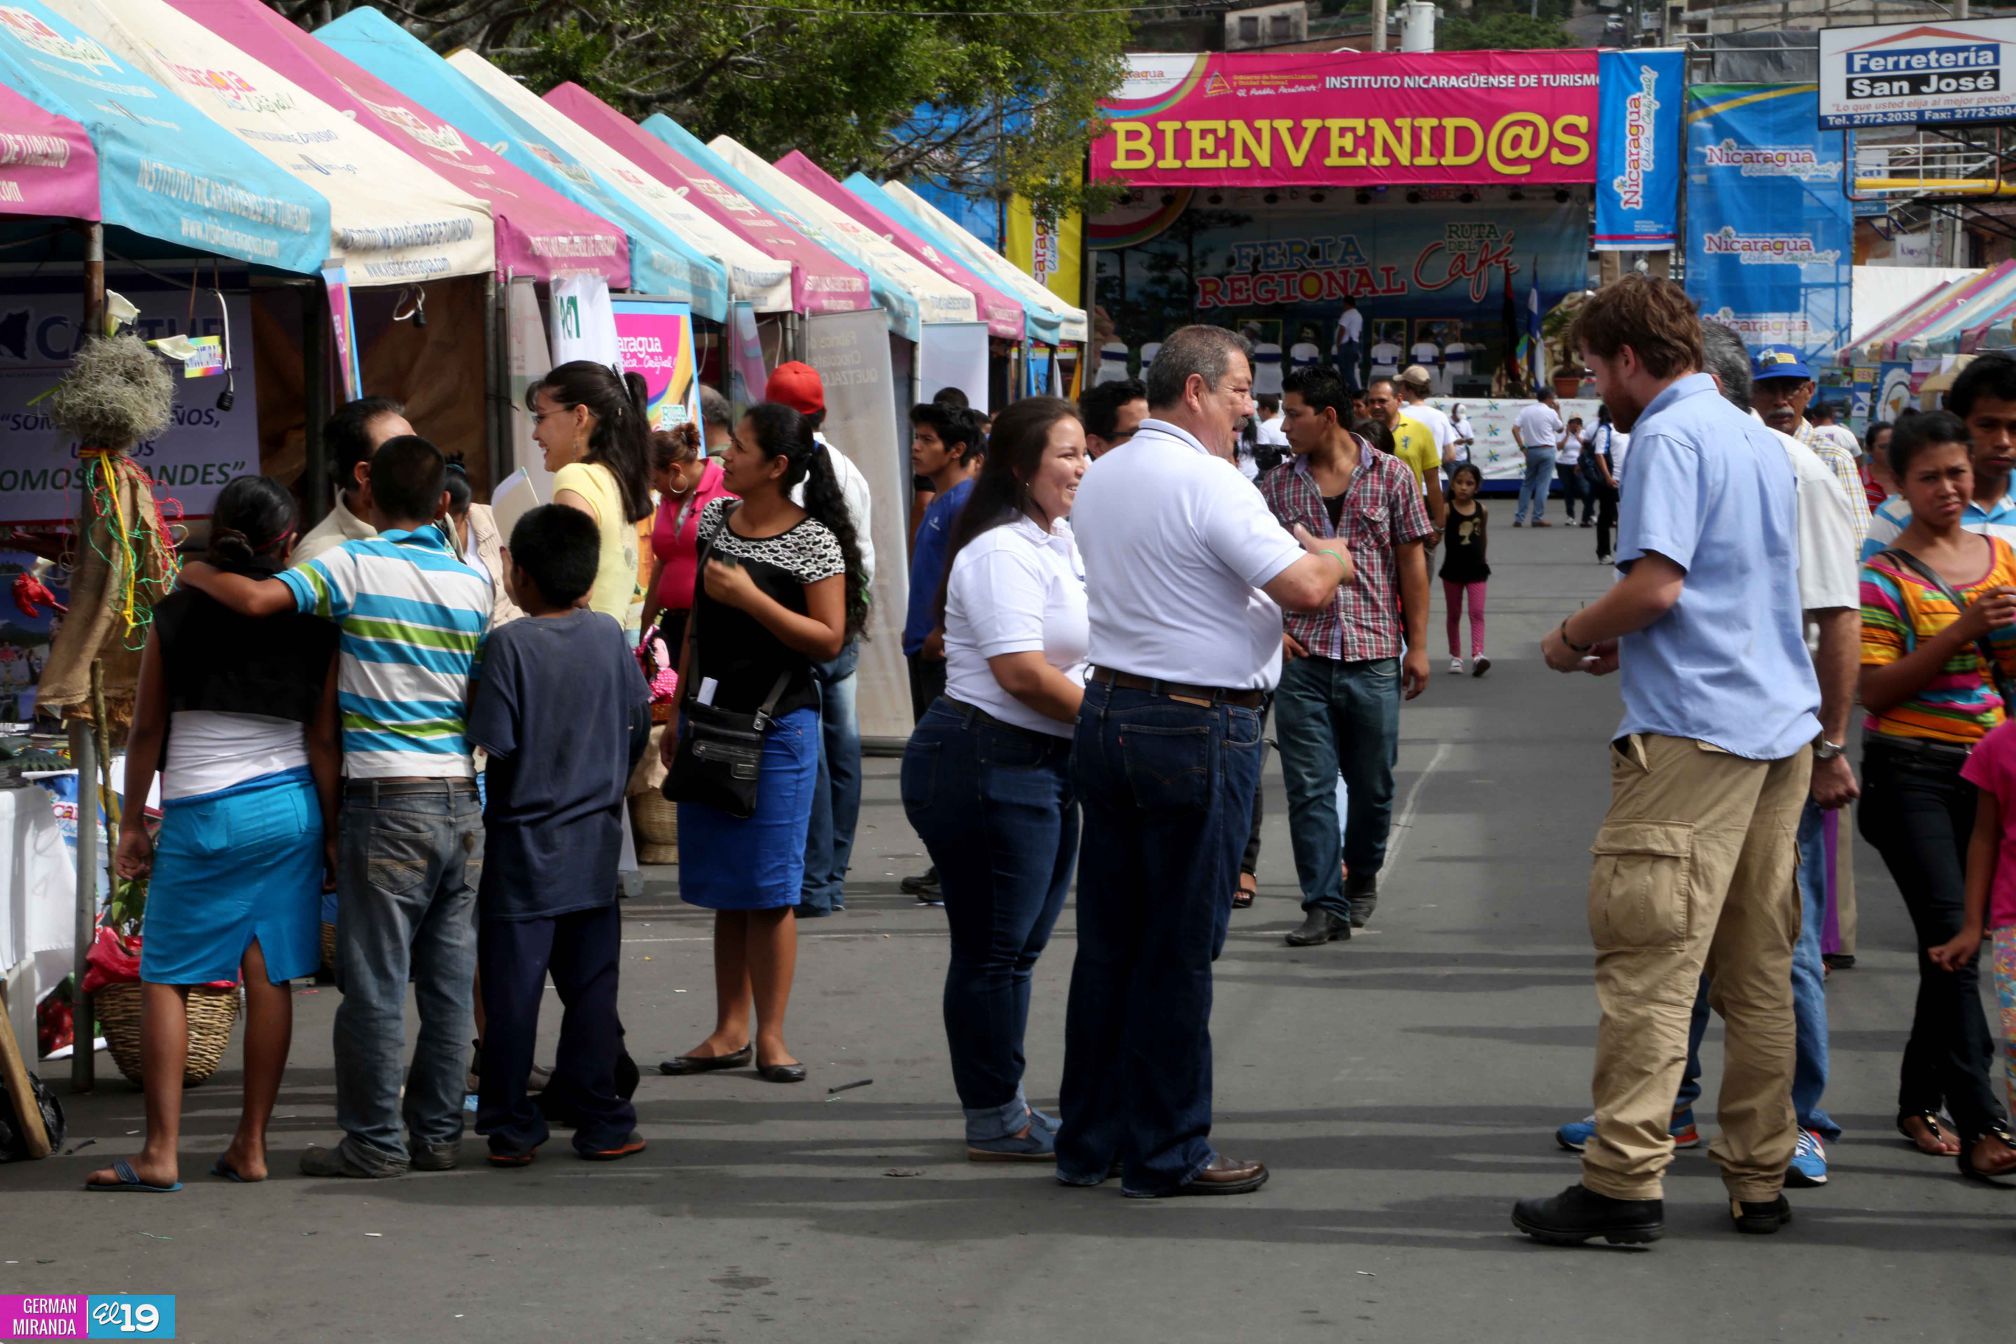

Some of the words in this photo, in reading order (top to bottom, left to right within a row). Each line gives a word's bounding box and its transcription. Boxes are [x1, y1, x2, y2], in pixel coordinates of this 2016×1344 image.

[1852, 47, 1994, 72] Ferretería
[1325, 75, 1400, 89] INSTITUTO
[1404, 73, 1516, 88] NICARAGÜENSE
[1519, 74, 1539, 87] DE
[1851, 78, 1910, 97] San
[1920, 71, 1995, 94] José
[1852, 104, 1872, 114] que
[1875, 99, 1904, 110] usted
[1907, 98, 1929, 111] elija
[1931, 97, 1945, 107] al
[1948, 96, 1974, 109] mejor
[1827, 114, 1849, 125] Tel.
[1853, 111, 1917, 124] 2772-2035
[1924, 109, 1951, 120] Fax:
[1110, 111, 1590, 175] BIENVENID@S
[1623, 96, 1645, 207] Nicaragua
[1708, 147, 1814, 168] Nicaragua
[1447, 223, 1499, 240] RUTA
[1233, 235, 1367, 272] FERIA
[1447, 239, 1477, 252] DEL
[1706, 235, 1812, 256] Nicaragua
[1197, 265, 1407, 308] REGIONAL
